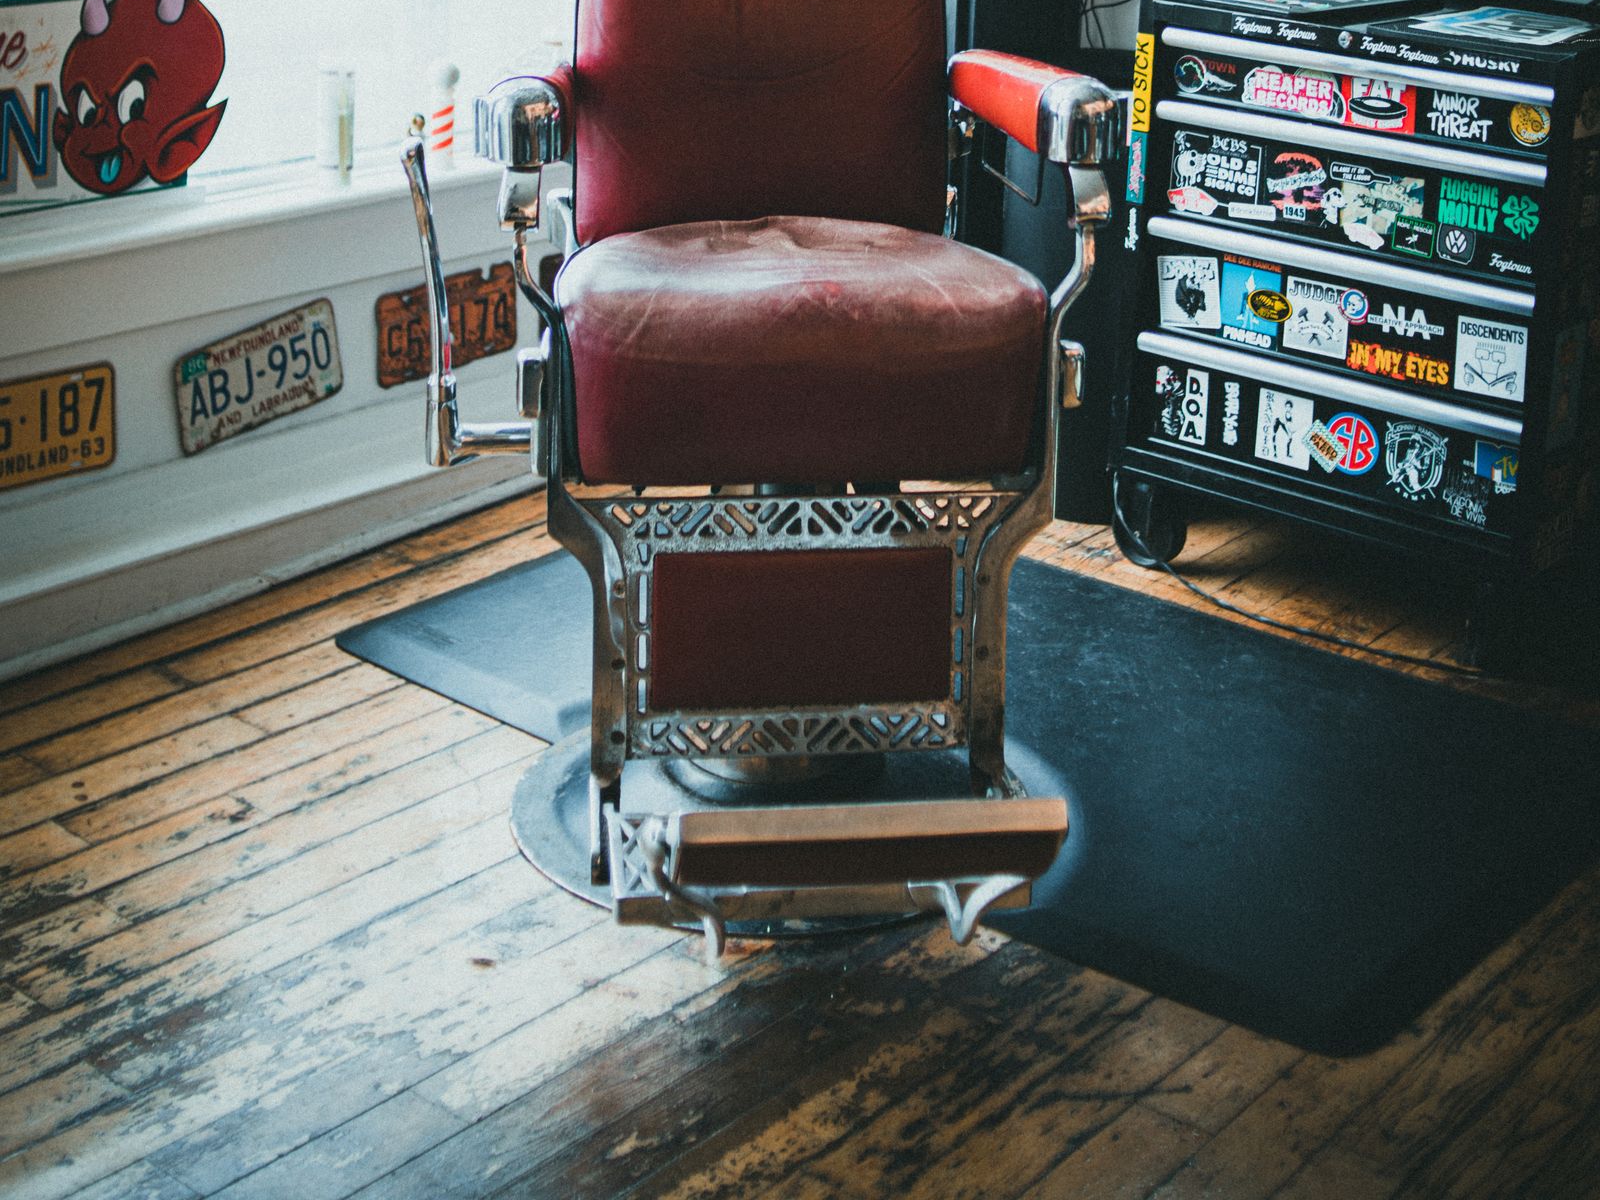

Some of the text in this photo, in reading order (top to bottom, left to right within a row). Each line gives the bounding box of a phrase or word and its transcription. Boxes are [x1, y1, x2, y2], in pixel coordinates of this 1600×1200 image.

[1233, 16, 1273, 35] Fogtown
[1277, 22, 1317, 41] Fogtown
[1396, 43, 1439, 65] Fogtown
[1134, 39, 1150, 92] SICK
[1203, 58, 1237, 75] TOWN
[1462, 51, 1520, 73] HUSKY
[1255, 69, 1332, 99] REAPER
[1351, 76, 1407, 100] FAT
[1133, 96, 1146, 126] YO
[1255, 88, 1330, 113] RECORDS
[1432, 90, 1480, 119] MINOR
[1427, 111, 1493, 142] THREAT
[1206, 153, 1244, 171] OLD
[1204, 178, 1255, 197] SIGN CO
[1217, 168, 1257, 187] DIME
[1440, 176, 1499, 209] FLOGGING
[1284, 206, 1305, 219] 1945
[1438, 198, 1499, 234] MOLLY
[1489, 253, 1533, 275] Fogtown
[1369, 315, 1444, 335] NEGATIVE APPROACH
[1382, 303, 1431, 340] NA
[1460, 321, 1525, 345] DESCENDENTS
[211, 318, 300, 366] NEWFOUNDLAND
[1222, 325, 1272, 349] PINHEAD
[190, 326, 331, 427] ABJ-950
[1350, 342, 1449, 385] IN MY EYES
